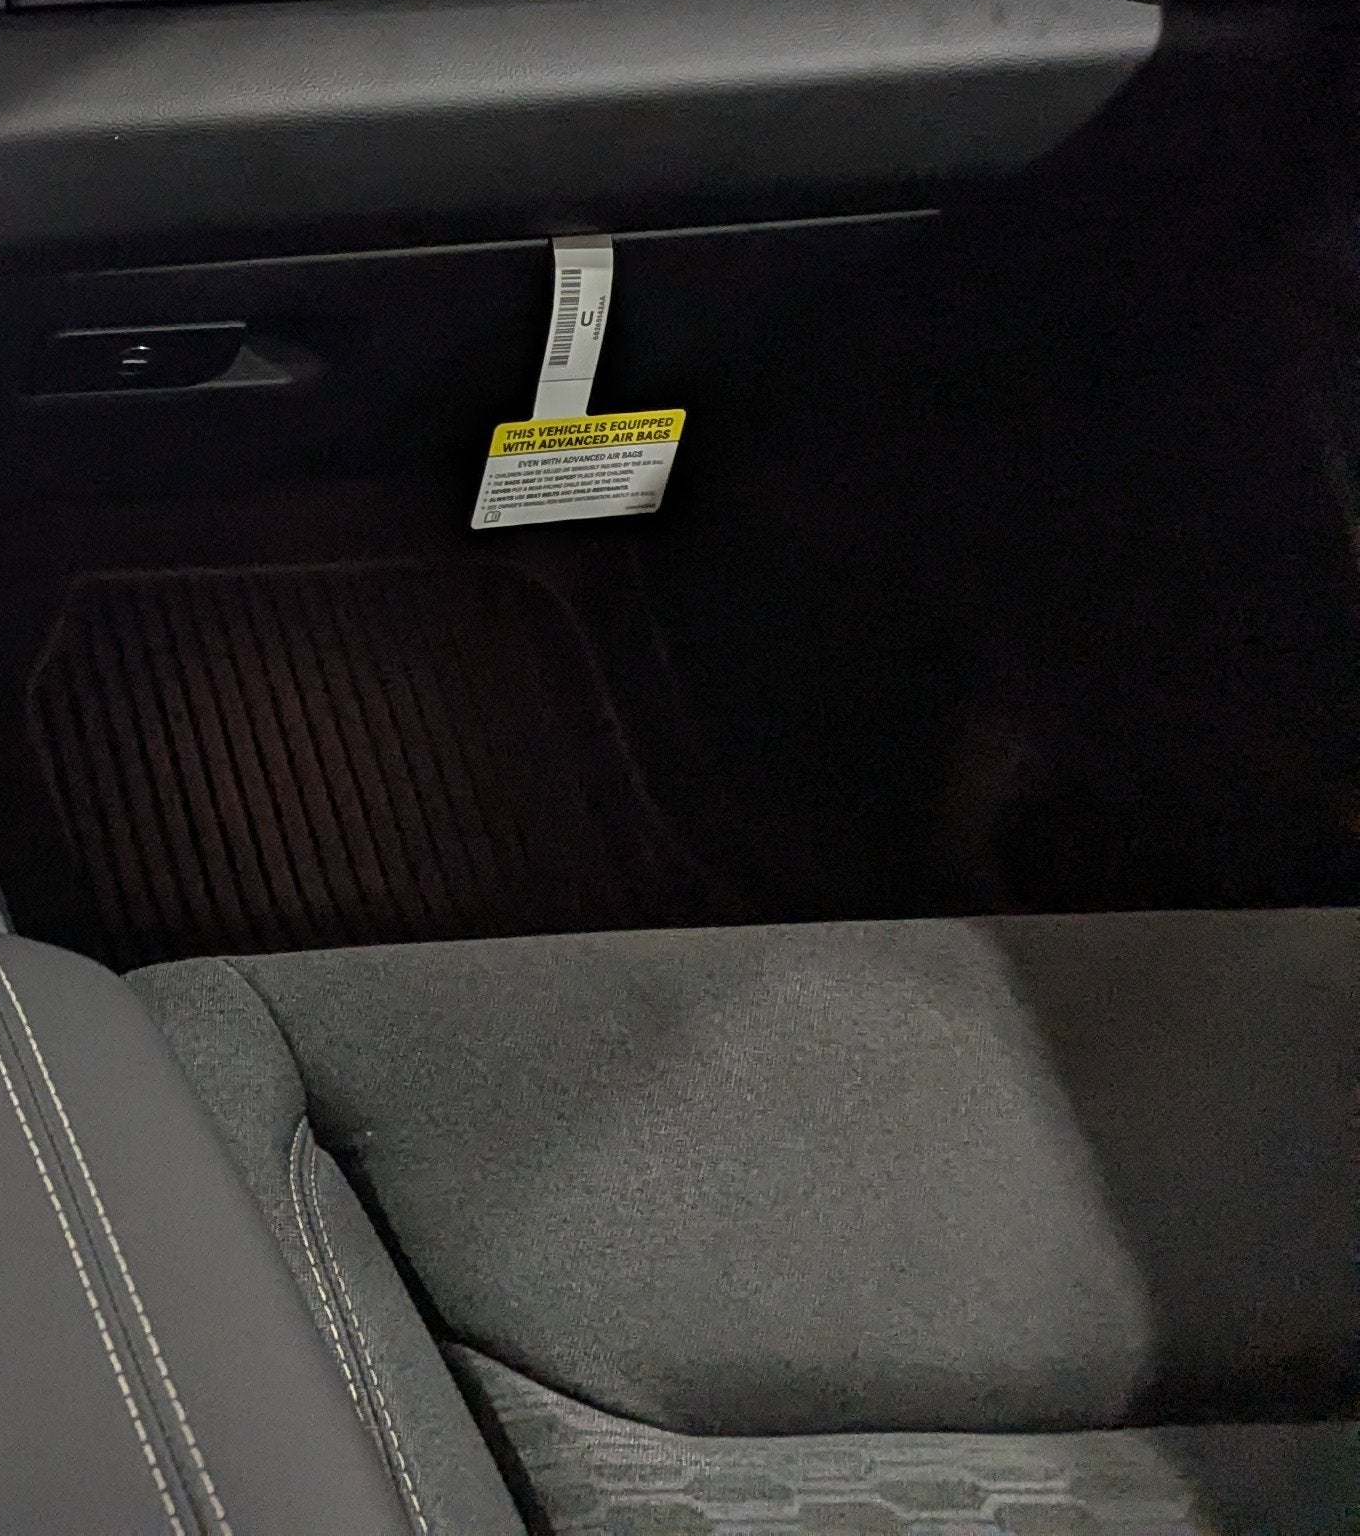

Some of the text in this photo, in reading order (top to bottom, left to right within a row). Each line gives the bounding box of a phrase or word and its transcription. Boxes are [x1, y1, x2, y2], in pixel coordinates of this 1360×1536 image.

[581, 311, 594, 327] U
[506, 417, 674, 440] THIS VEHICLE IS EQUIPPED
[503, 429, 671, 452] WITH ADVANCED AIR BAGS
[517, 459, 540, 468] EVEN
[562, 453, 606, 464] ADVANCED
[606, 452, 620, 460] AIR
[620, 450, 643, 459] BAGS
